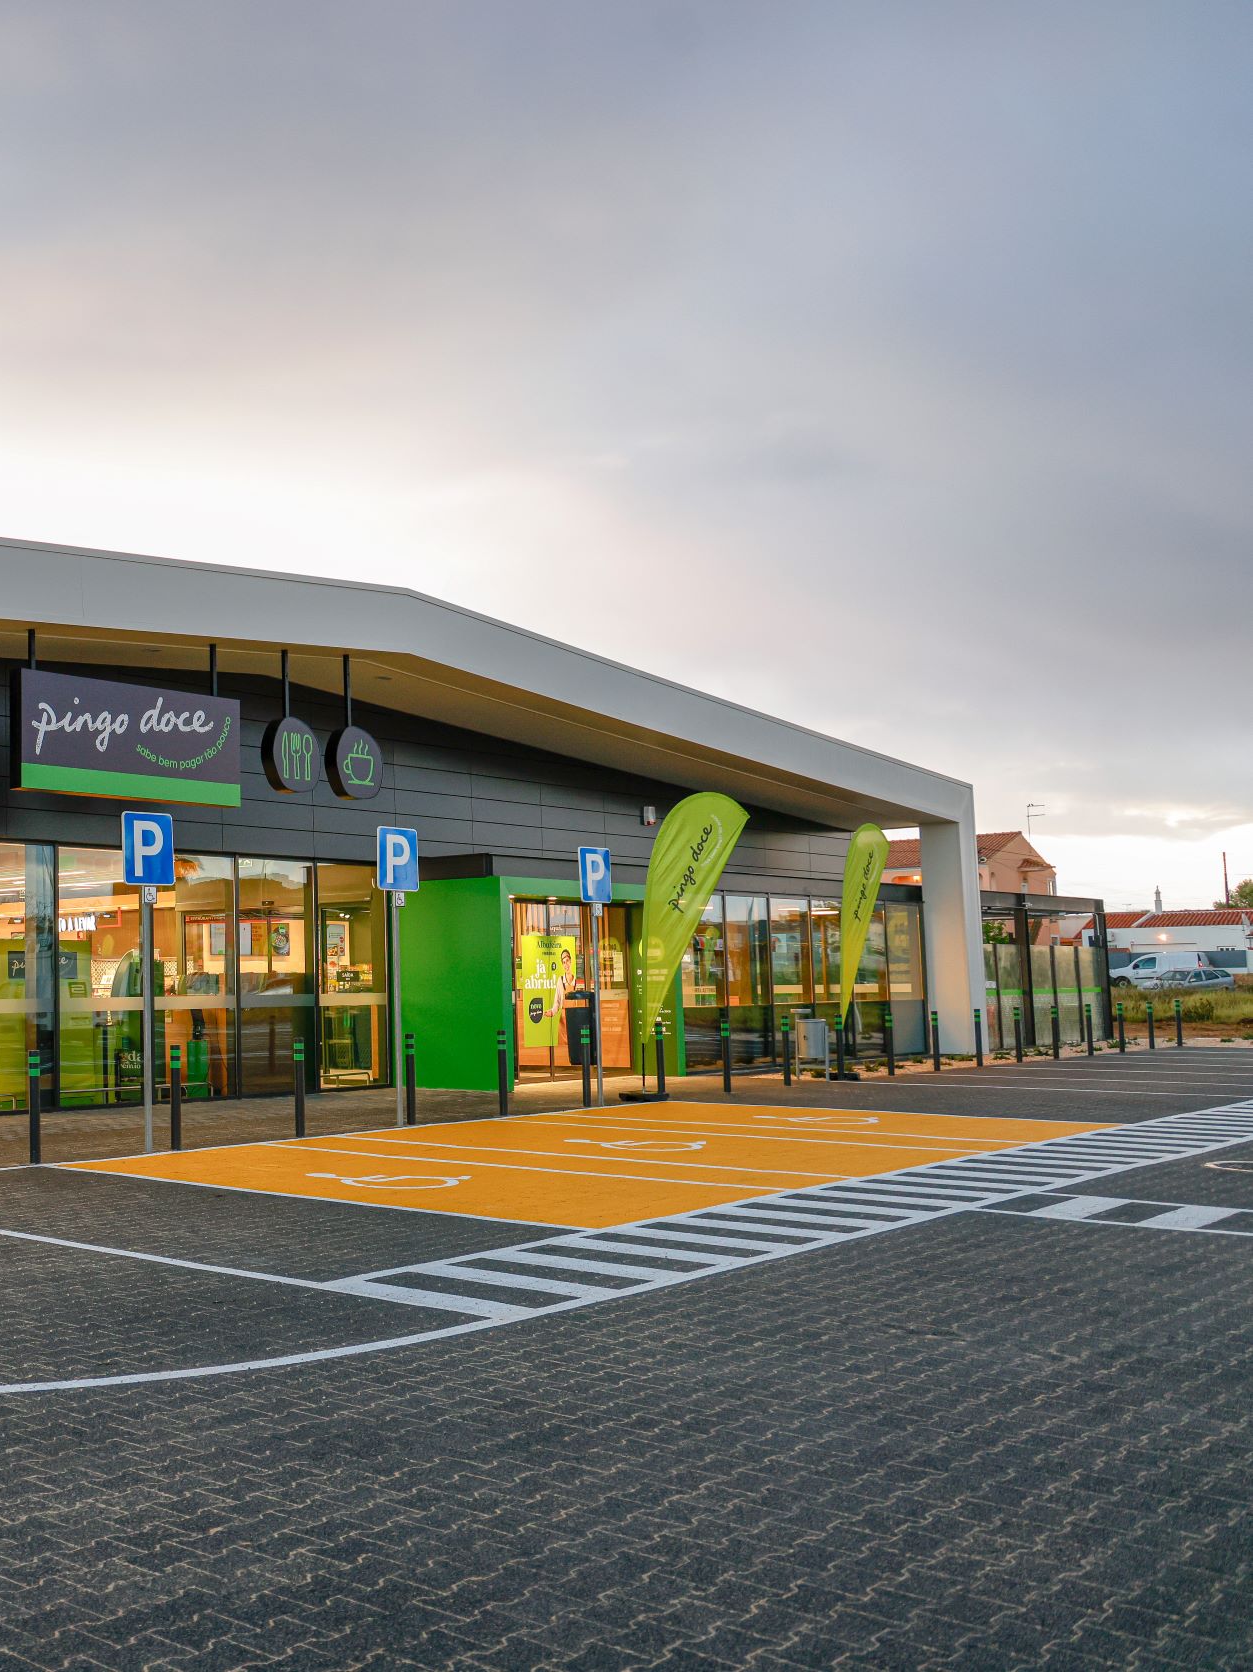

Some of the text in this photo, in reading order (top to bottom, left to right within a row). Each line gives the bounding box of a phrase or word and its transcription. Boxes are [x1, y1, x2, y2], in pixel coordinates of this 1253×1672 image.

[31, 696, 215, 756] pingo doce
[136, 716, 232, 770] sabe bem pagar tão pouco
[133, 820, 164, 877] P
[385, 834, 411, 884] P
[585, 853, 605, 897] P
[668, 866, 697, 914] pingo
[690, 823, 713, 862] doce
[524, 974, 557, 989] abriu!
